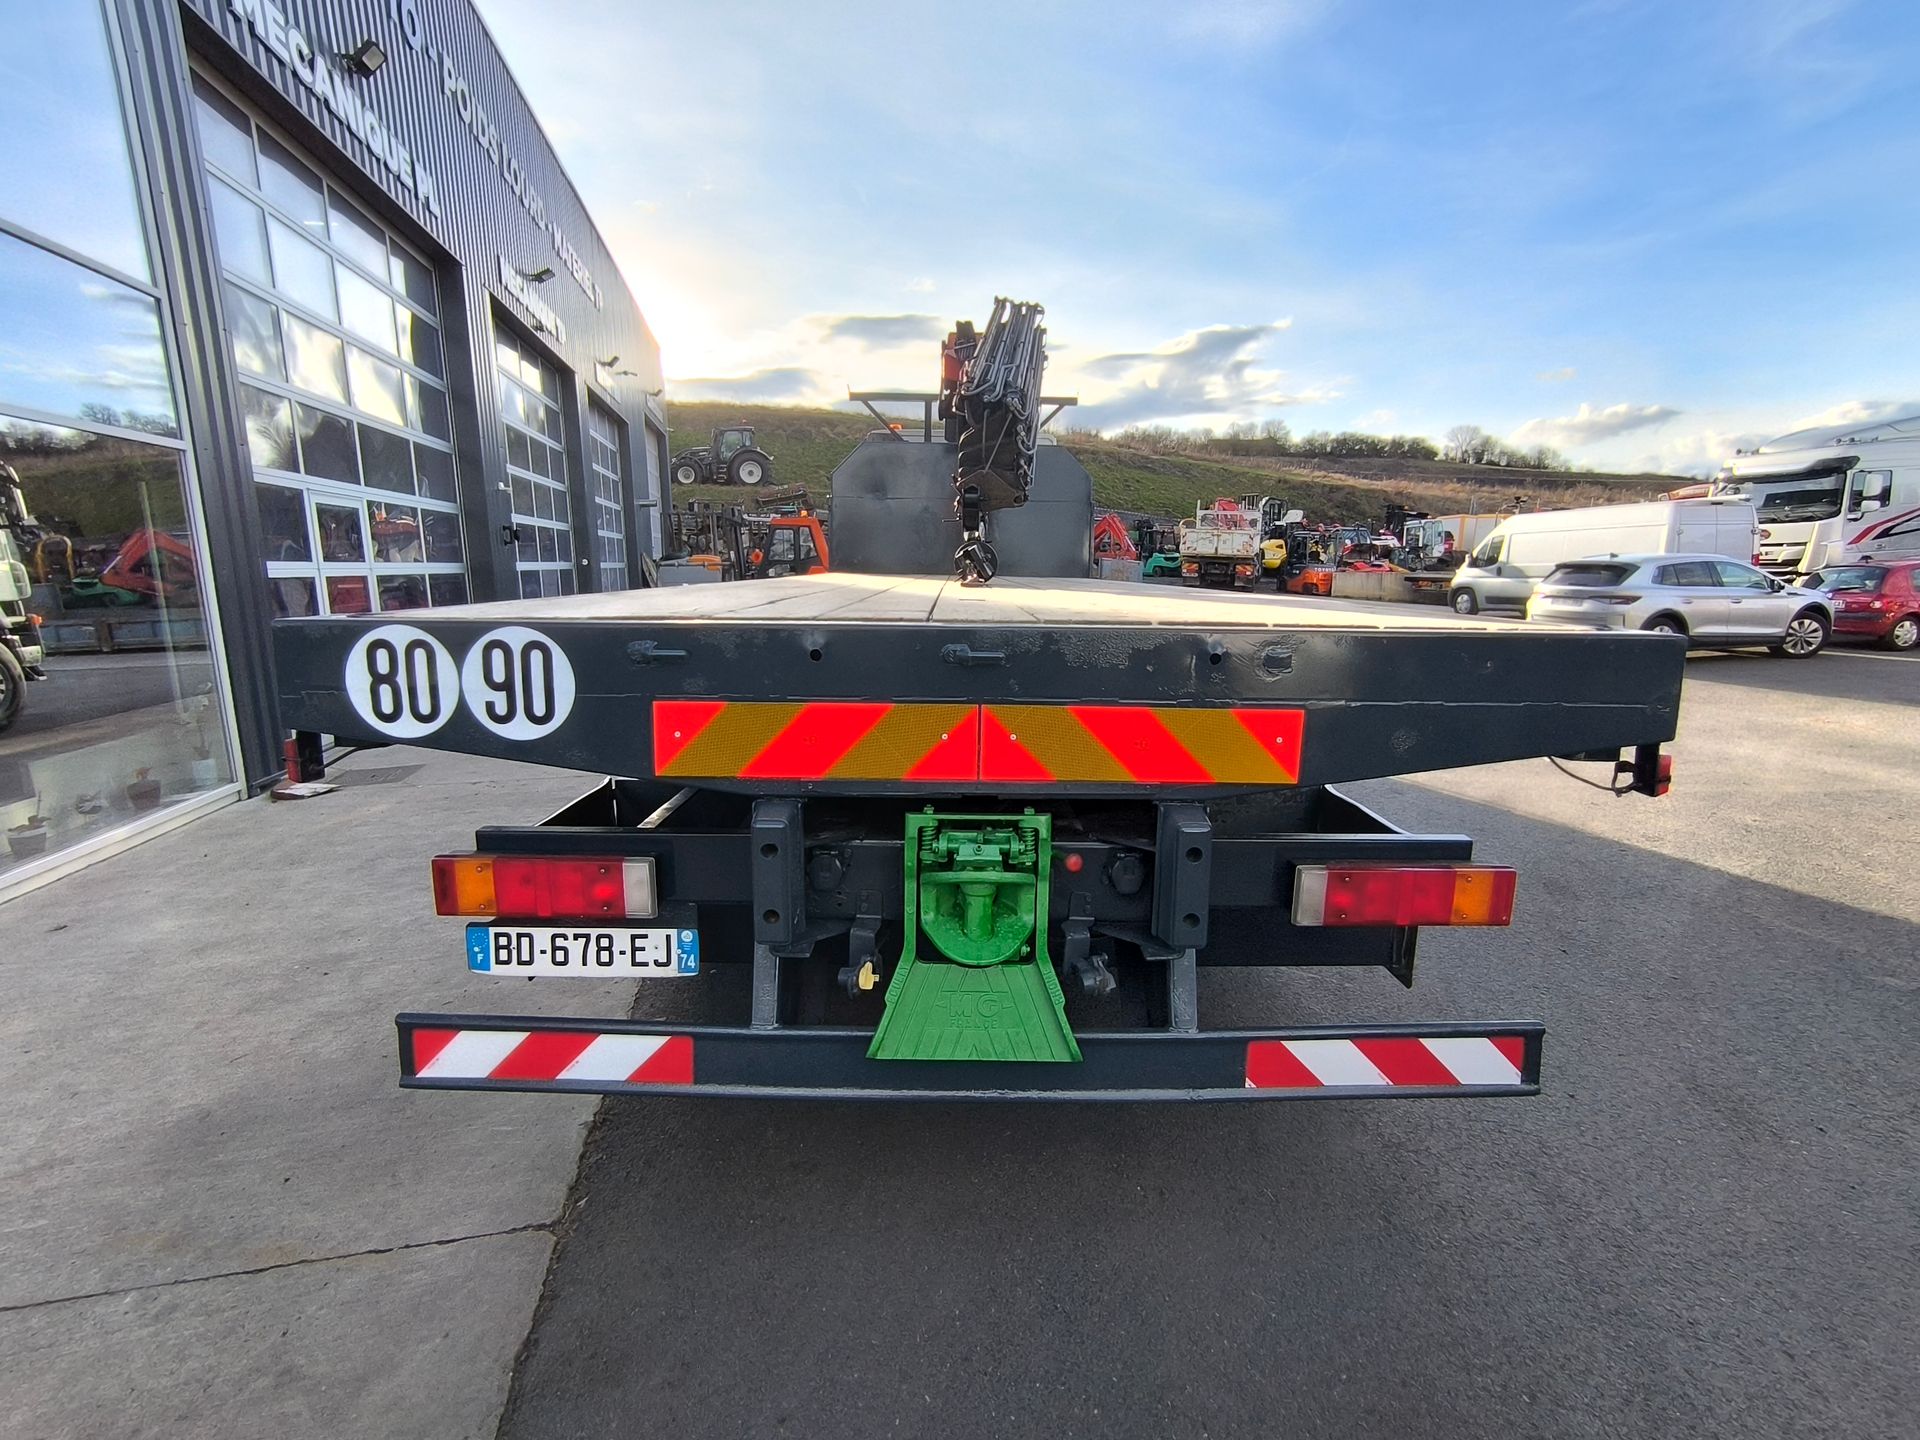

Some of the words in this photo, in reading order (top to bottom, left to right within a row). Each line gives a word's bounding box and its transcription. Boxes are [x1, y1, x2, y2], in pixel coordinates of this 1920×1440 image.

[229, 0, 413, 191] MECANIQUE
[414, 161, 440, 217] PL
[443, 50, 499, 165] POIDS
[502, 143, 546, 231] LOURD
[366, 638, 441, 724] 80
[482, 639, 556, 726] 90
[477, 953, 484, 964] F
[494, 932, 672, 968] BD-678-EJ
[680, 953, 696, 969] 74
